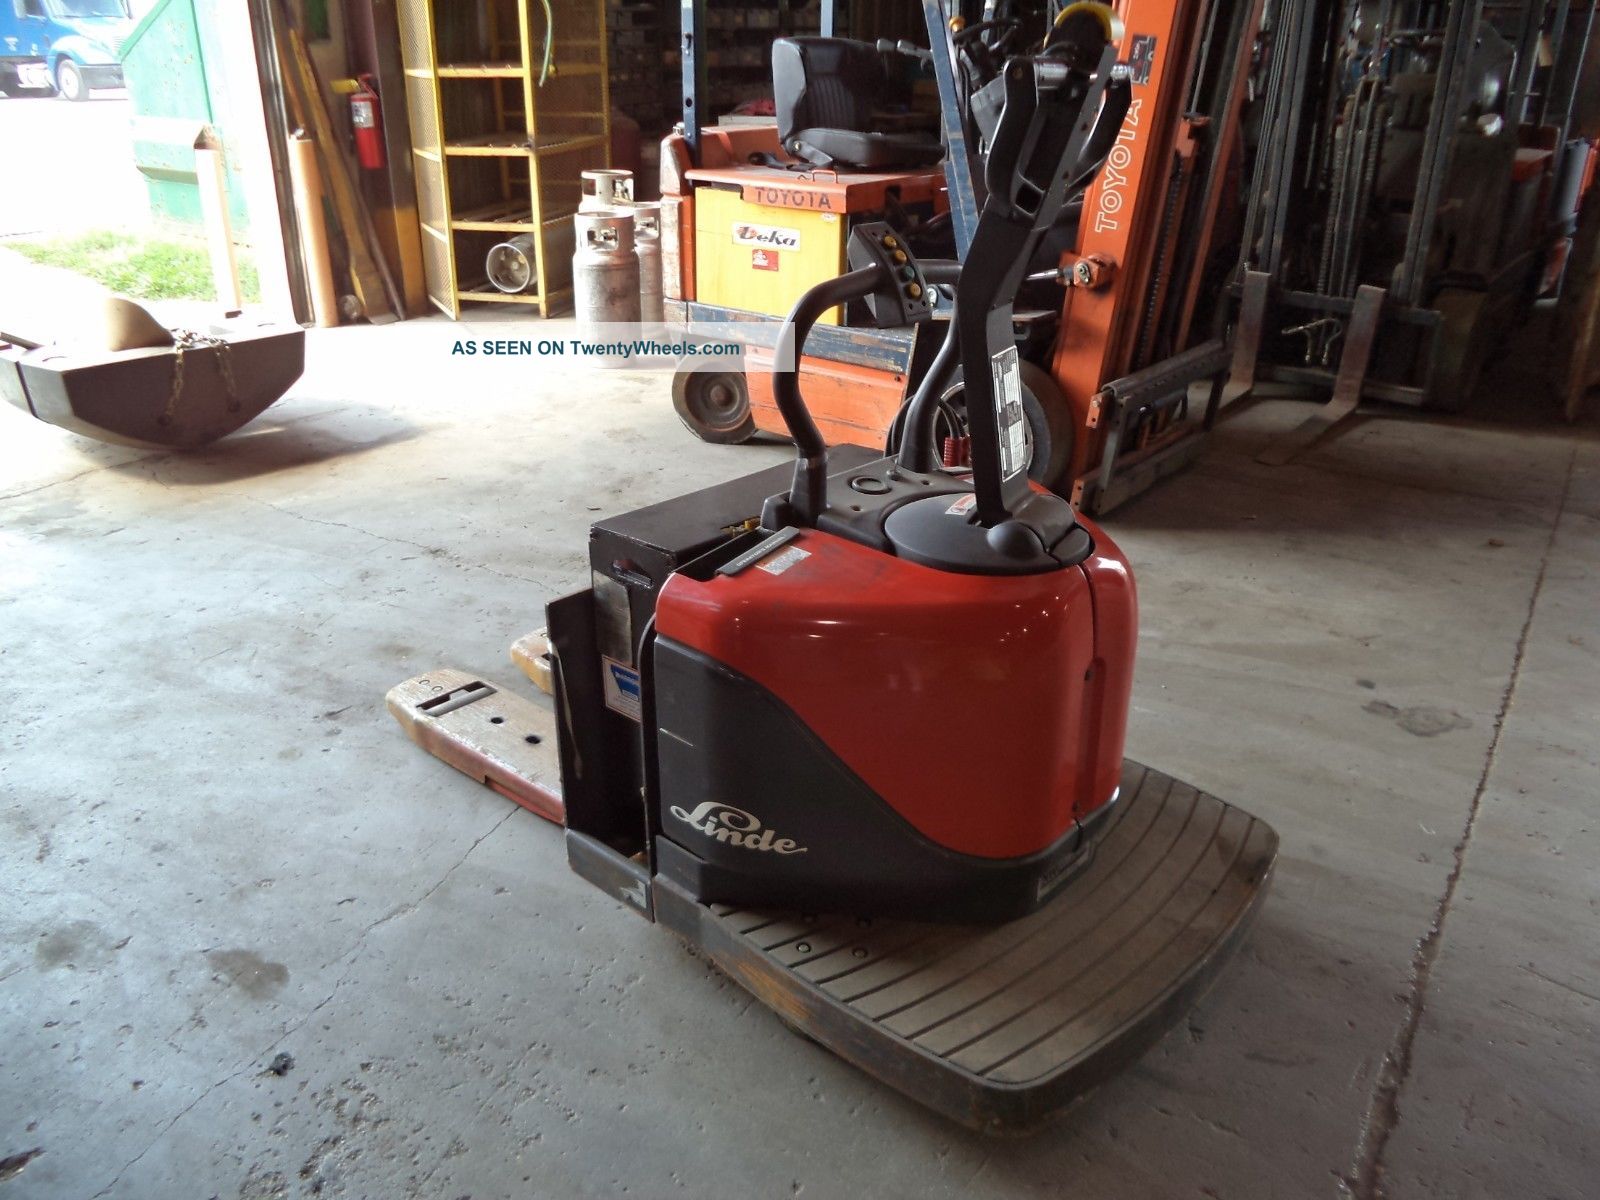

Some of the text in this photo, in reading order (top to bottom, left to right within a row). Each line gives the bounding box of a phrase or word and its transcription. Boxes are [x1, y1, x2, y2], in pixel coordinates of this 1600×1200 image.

[1095, 99, 1142, 232] TOYOTA
[755, 186, 831, 209] TOYOTA
[670, 801, 808, 854] Linde
